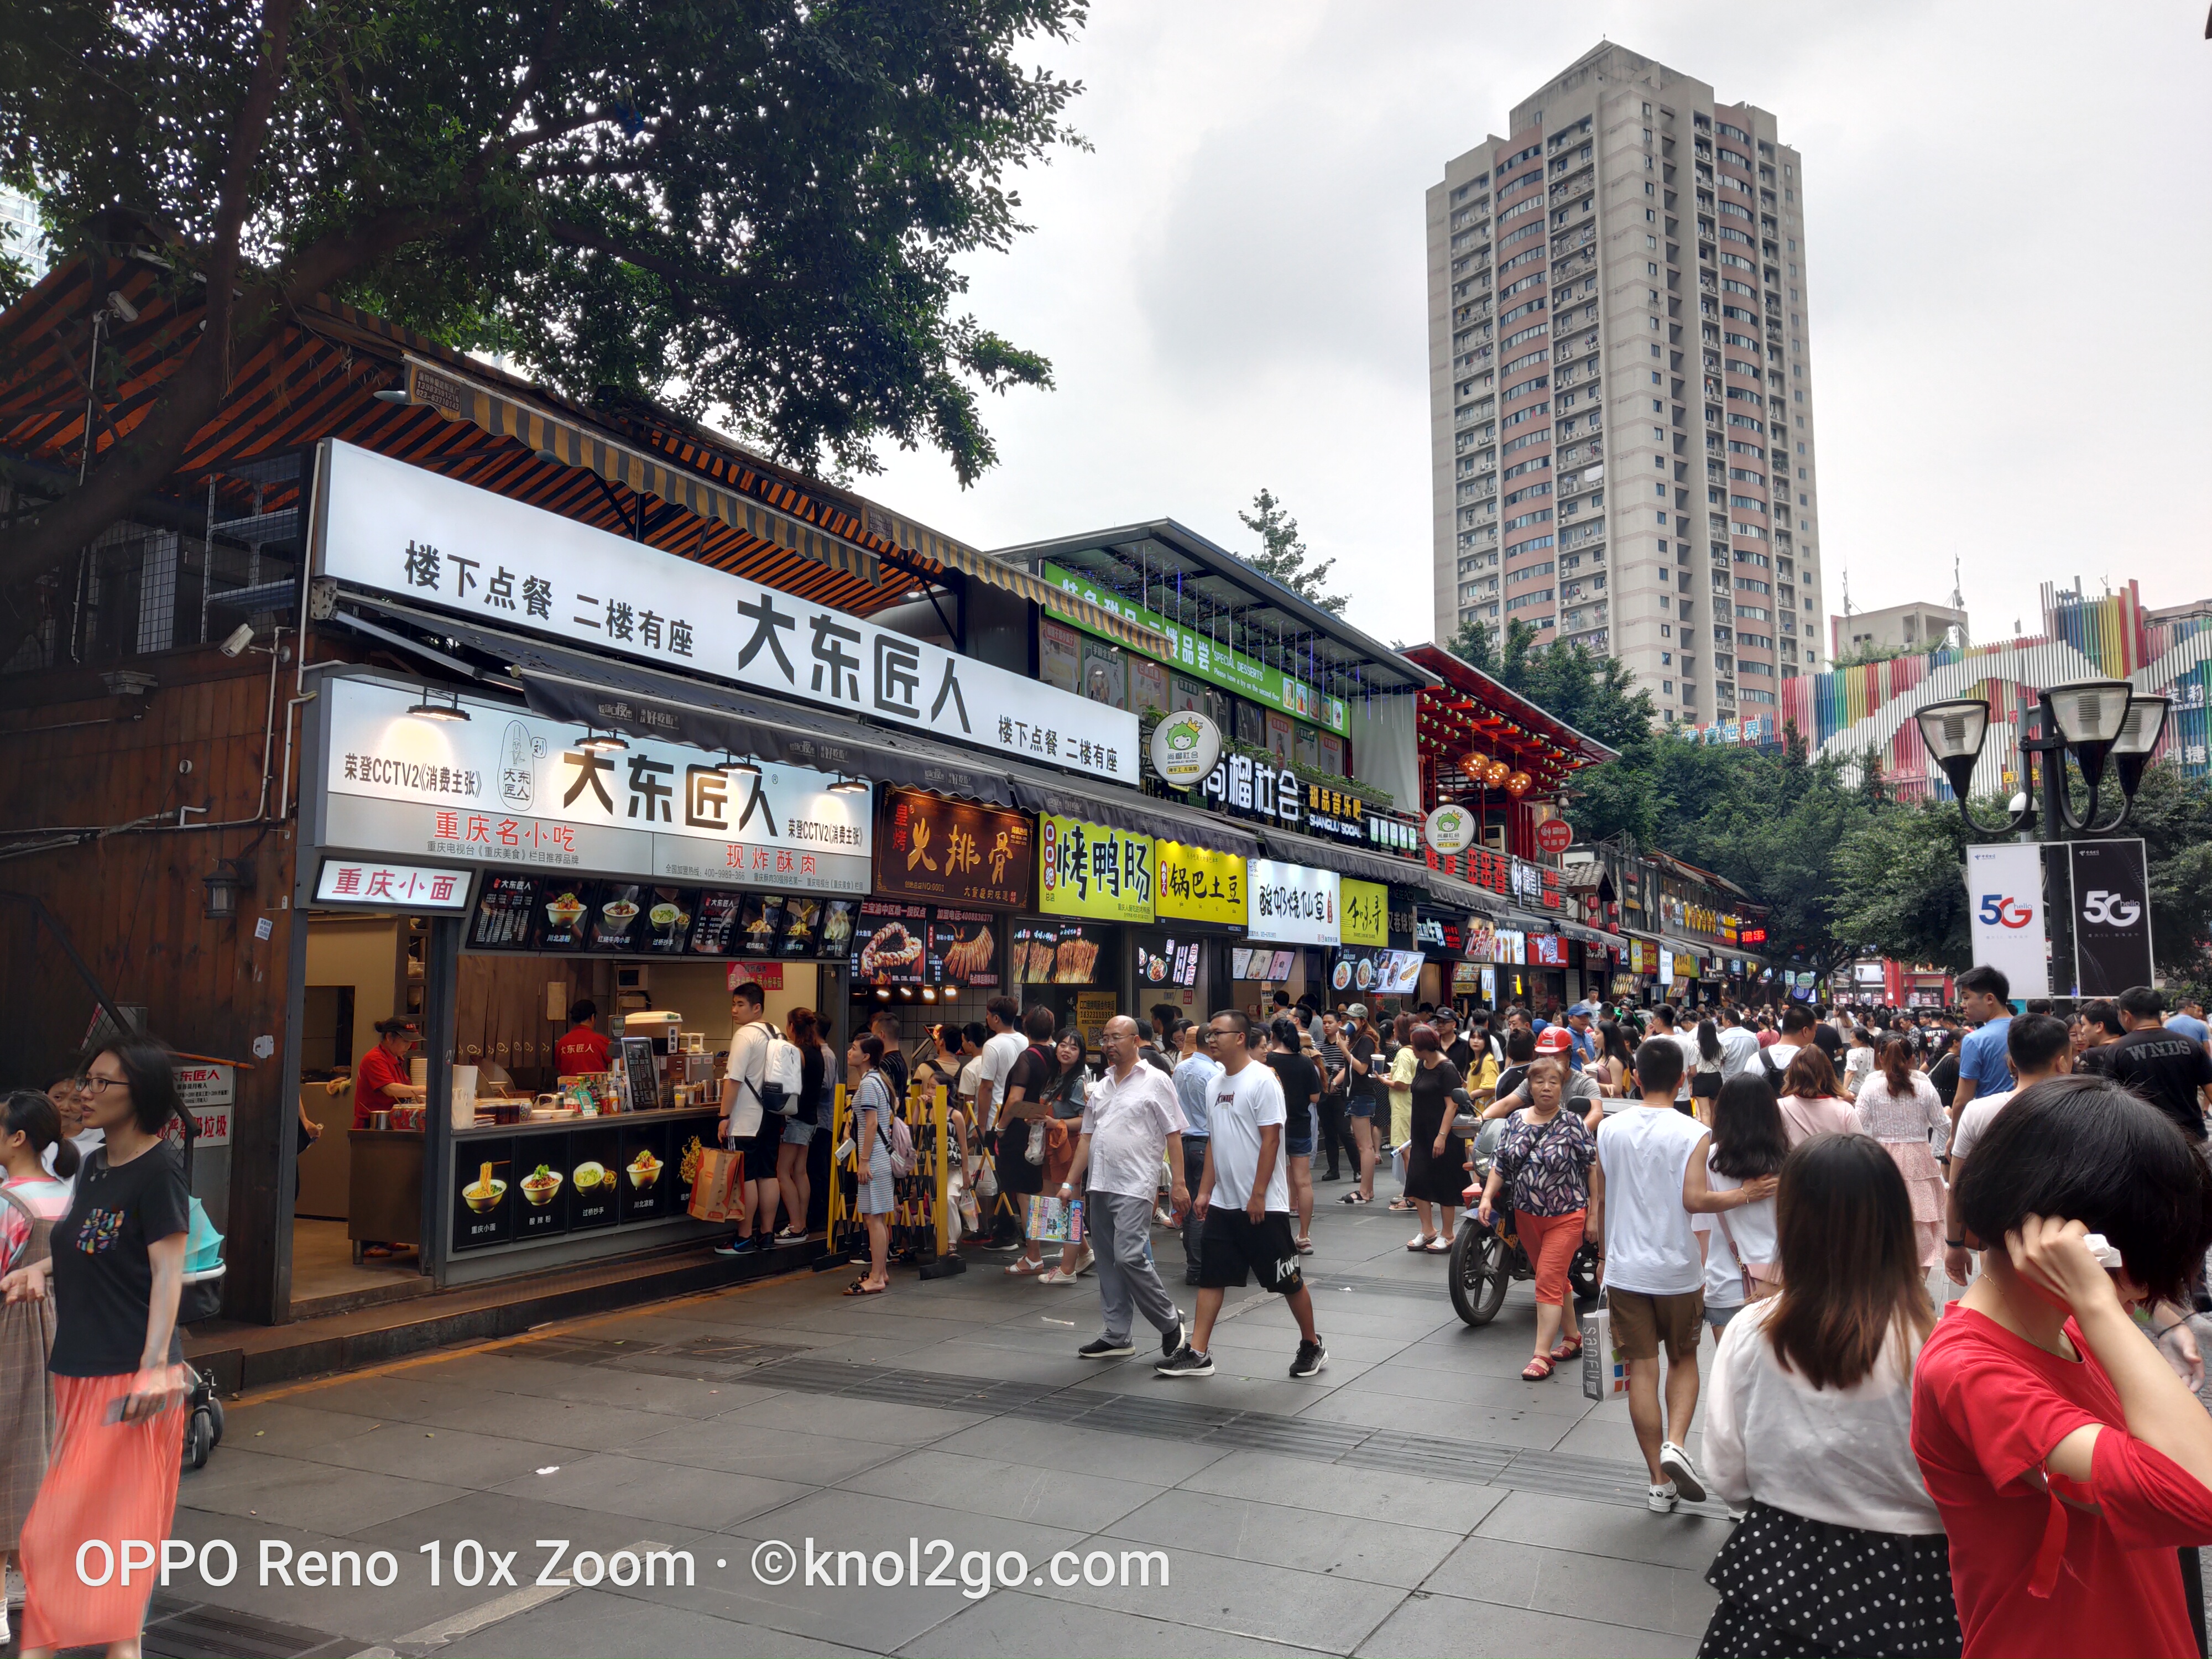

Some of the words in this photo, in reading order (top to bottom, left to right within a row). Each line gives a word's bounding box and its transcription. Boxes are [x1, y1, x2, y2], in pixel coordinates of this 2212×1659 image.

[404, 540, 553, 620] 楼下点餐
[573, 593, 693, 658] 二楼有座
[737, 593, 972, 734] 大东匠人
[1214, 650, 1235, 669] SPECIAL
[1237, 661, 1263, 682] DESSERTS
[1214, 667, 1226, 679] Please
[1227, 672, 1236, 683] have
[1259, 688, 1272, 700] second
[1272, 692, 1280, 702] floor
[998, 714, 1058, 757] 楼下点餐
[1065, 736, 1118, 772] 二楼有座
[344, 752, 482, 799] 荣登CCTV2《消费主张》
[564, 749, 778, 837] 大东匠人
[1309, 785, 1361, 821] 甜品音乐吧
[433, 810, 576, 852] 重庆名小吃
[787, 818, 863, 847] 荣登CCTV2《消费主张》
[426, 840, 580, 865] 重庆电视台《重庆美食》栏目推荐品牌
[726, 843, 816, 876] 现炸酥肉
[1056, 824, 1151, 905] 烤鸭肠
[331, 867, 457, 901] 重庆小面
[500, 880, 531, 891] 大东匠人
[704, 867, 745, 881] 400-9989-366
[1168, 862, 1241, 905] 锅巴土豆
[1468, 846, 1506, 894] 串串香
[711, 899, 734, 907] 大东匠人
[1388, 888, 1404, 900] HINESE
[1979, 894, 2033, 928] 5G
[2083, 890, 2141, 927] 5G
[2120, 899, 2141, 907] hello
[560, 1042, 594, 1055] 大东匠人
[471, 1223, 496, 1235] 重庆小面
